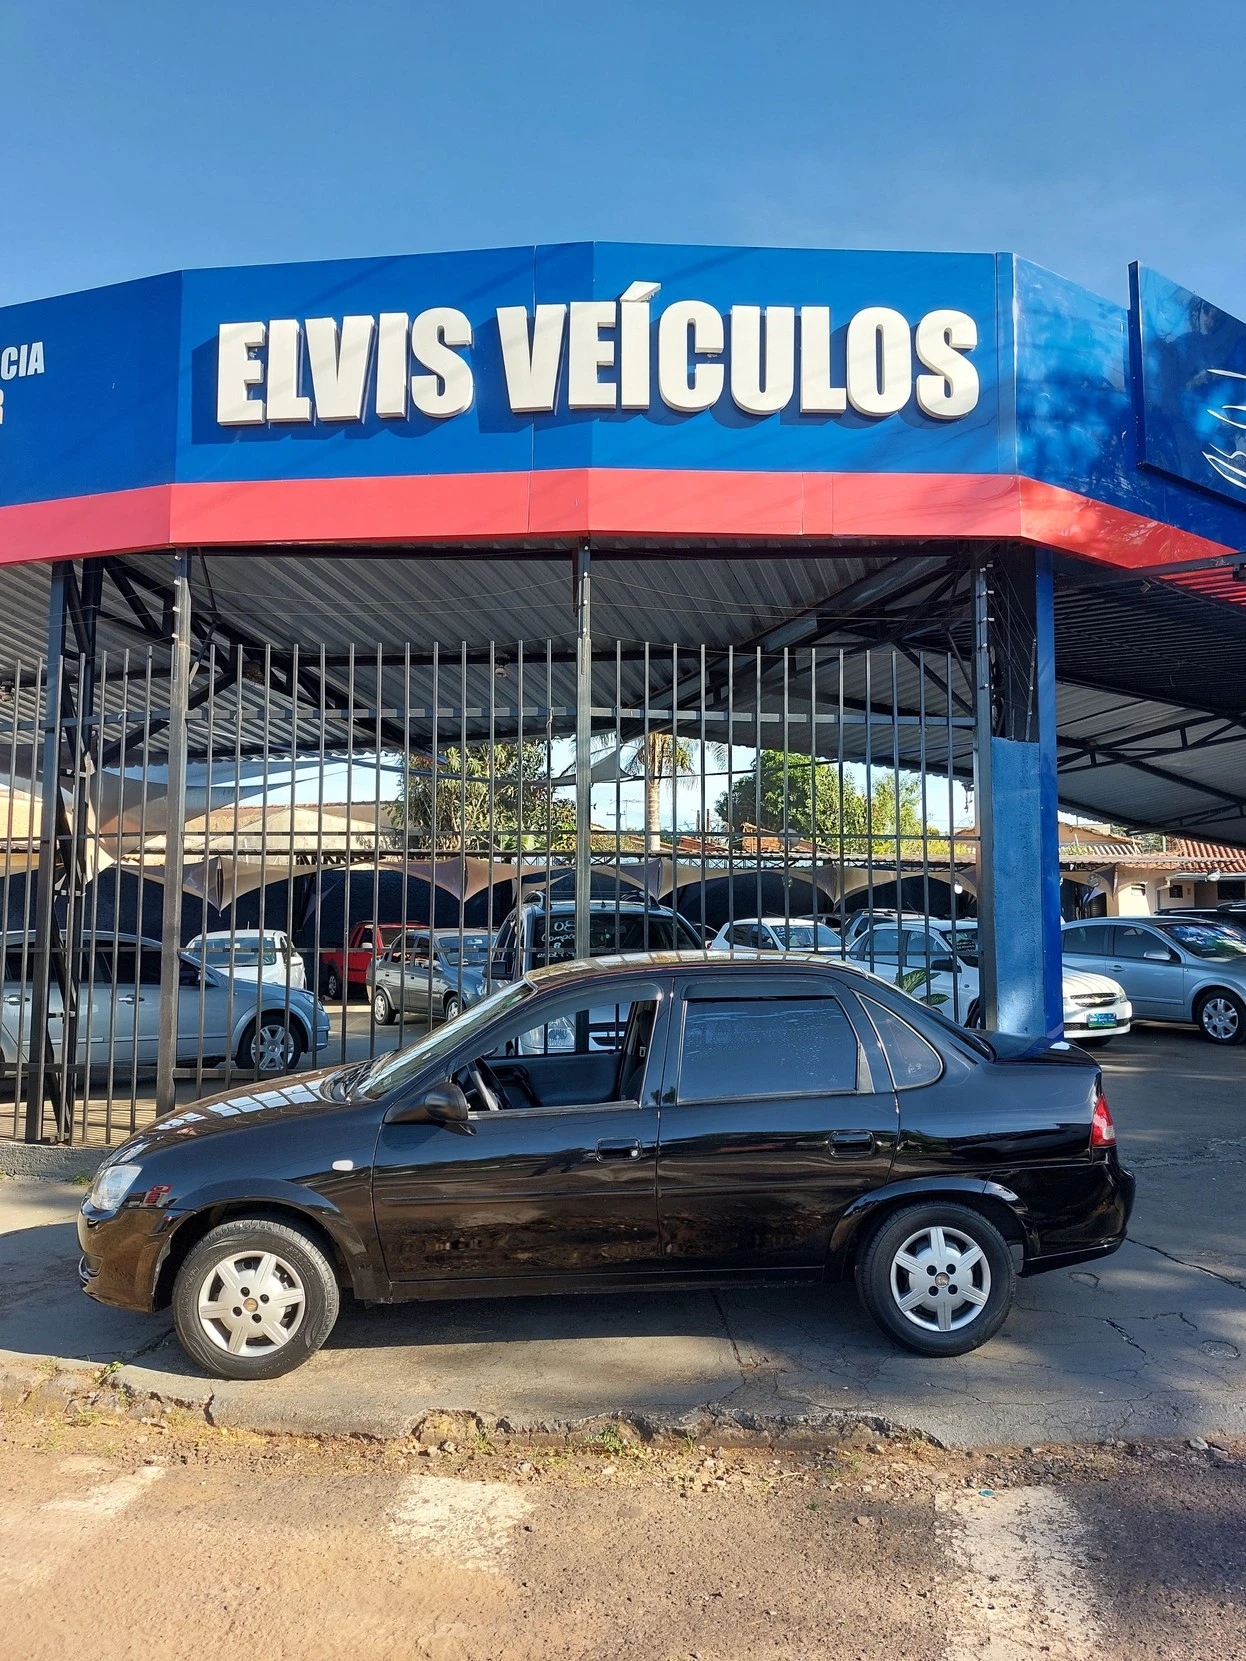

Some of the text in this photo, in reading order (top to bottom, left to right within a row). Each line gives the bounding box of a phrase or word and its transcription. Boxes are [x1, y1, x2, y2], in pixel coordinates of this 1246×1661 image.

[0, 341, 45, 381] CIA
[217, 280, 980, 425] ELVIS VEÍCULOS
